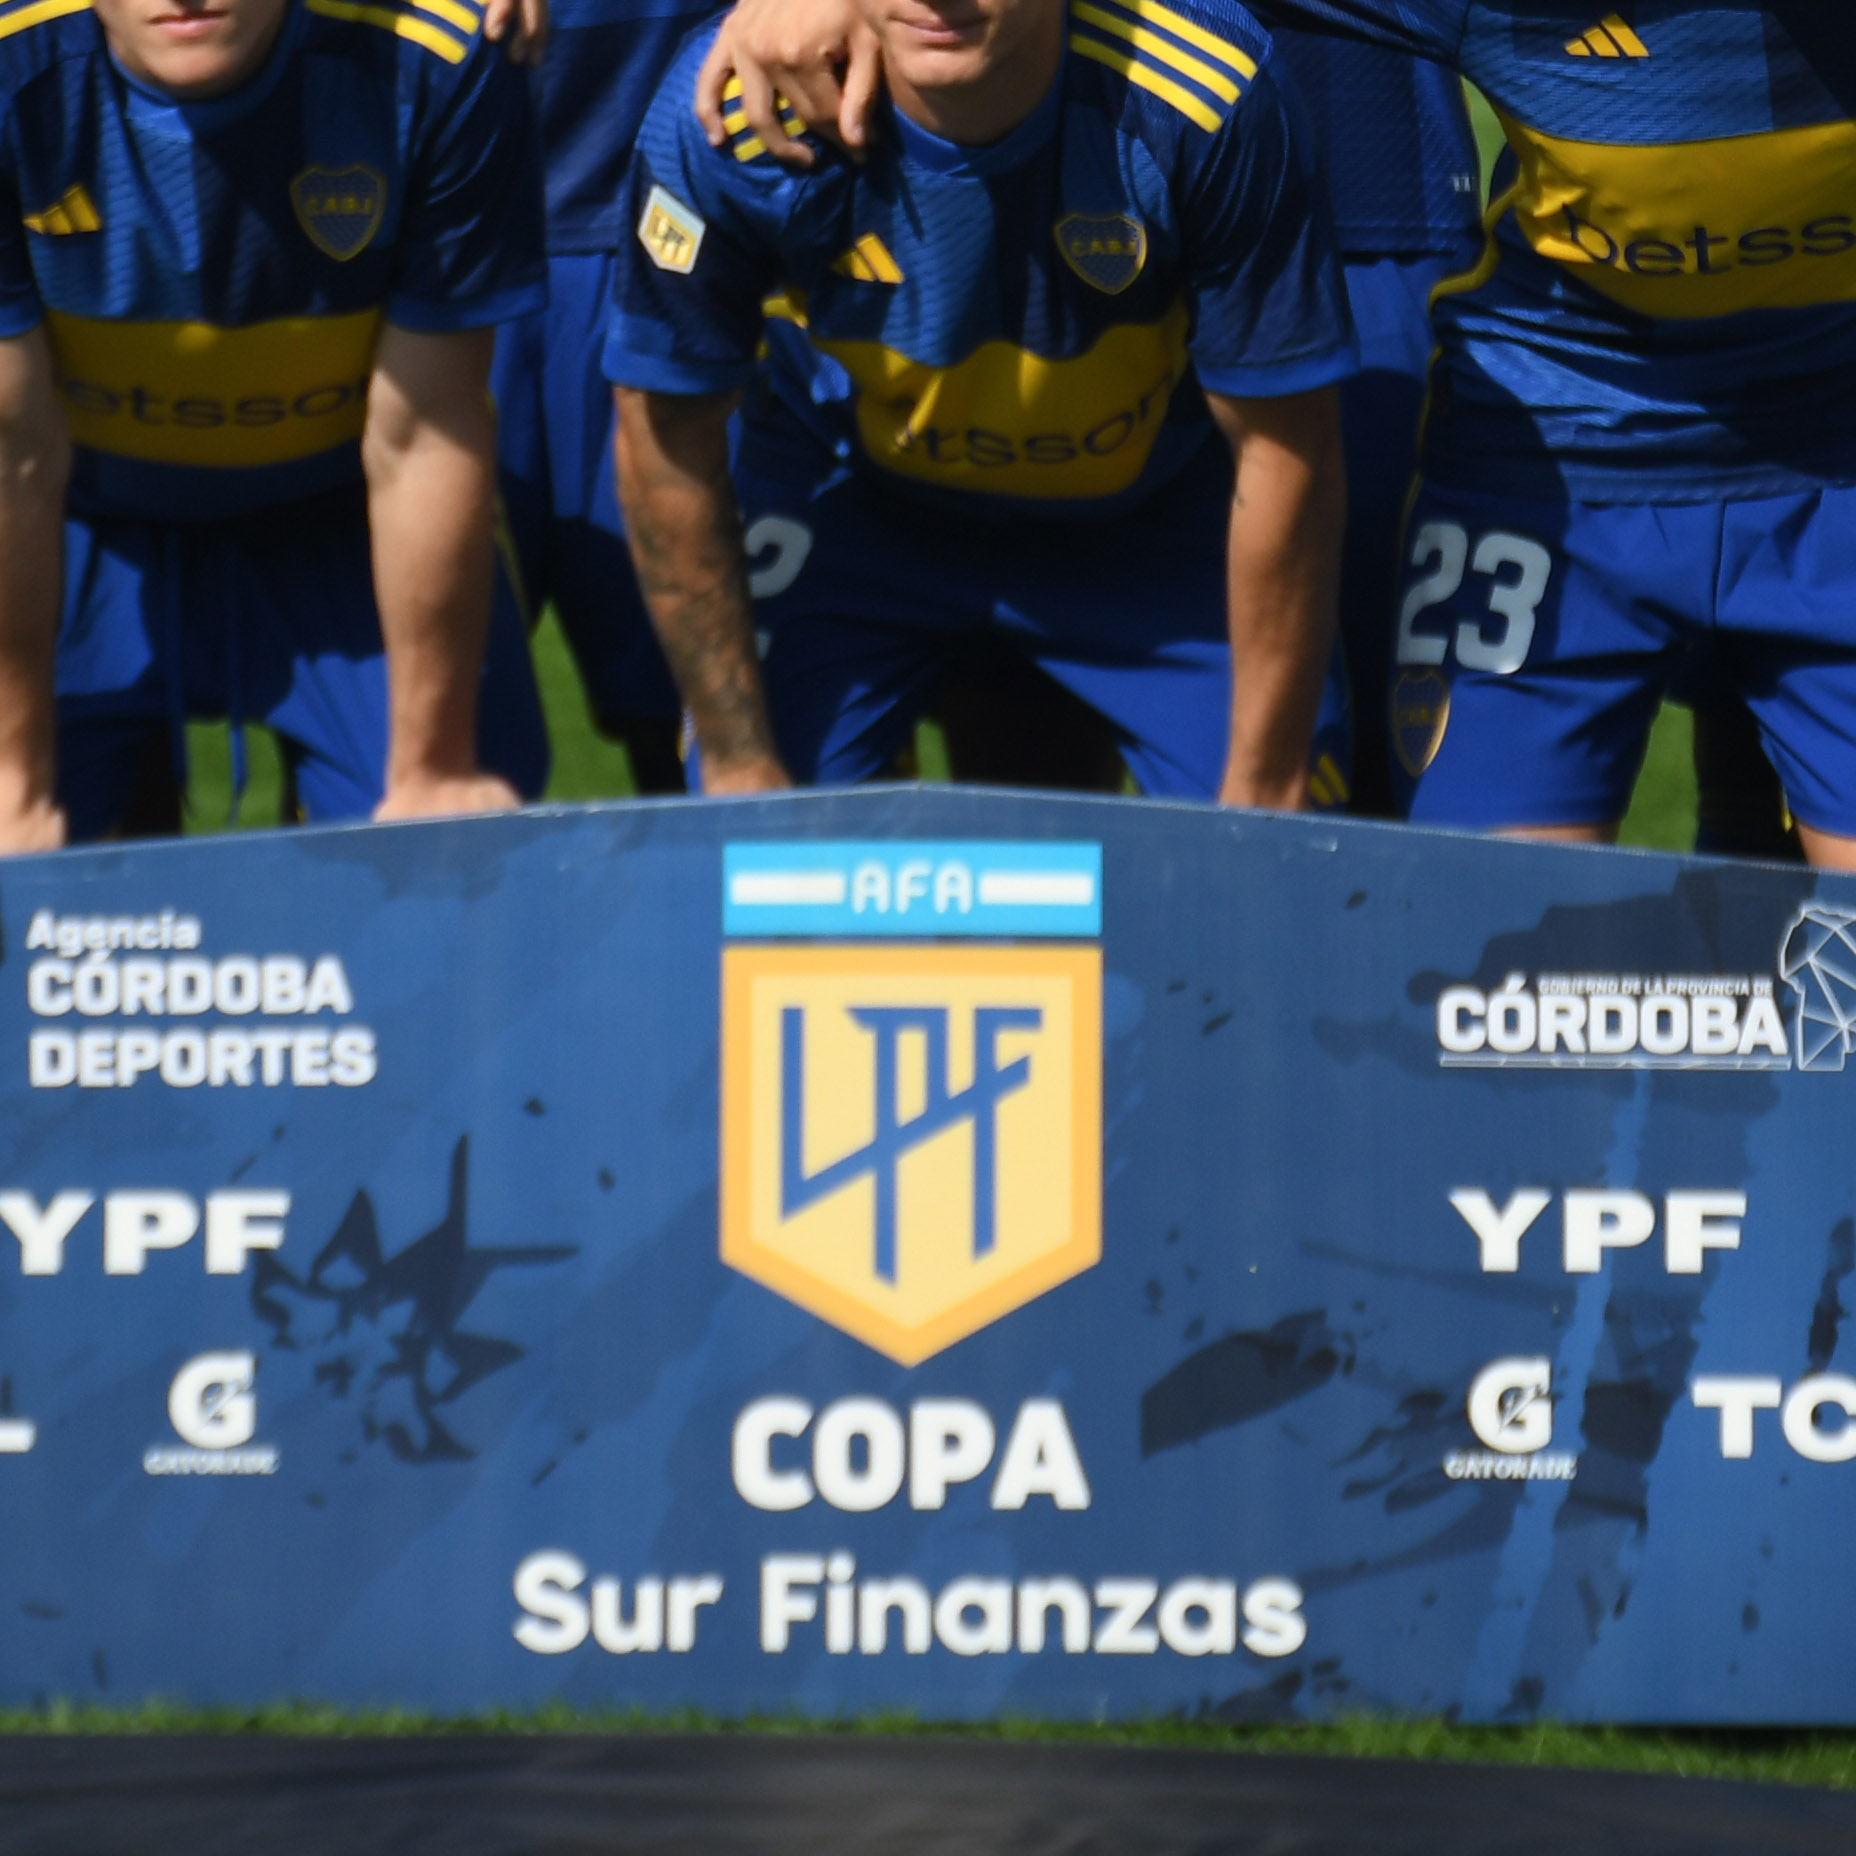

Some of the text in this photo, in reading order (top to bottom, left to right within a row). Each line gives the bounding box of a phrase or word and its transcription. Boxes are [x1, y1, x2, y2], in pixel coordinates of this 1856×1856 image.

[1396, 521, 1552, 676] 23
[850, 860, 973, 915] AFA
[26, 907, 202, 959] Agencia
[27, 948, 354, 1017] CÓRDOBA
[1437, 973, 1789, 1057] CÓRDOBA
[28, 1026, 379, 1088] DEPORTES
[1447, 1187, 1748, 1275] YPF
[732, 1396, 1091, 1513] COPA
[512, 1549, 1308, 1658] Sur Finanzas
